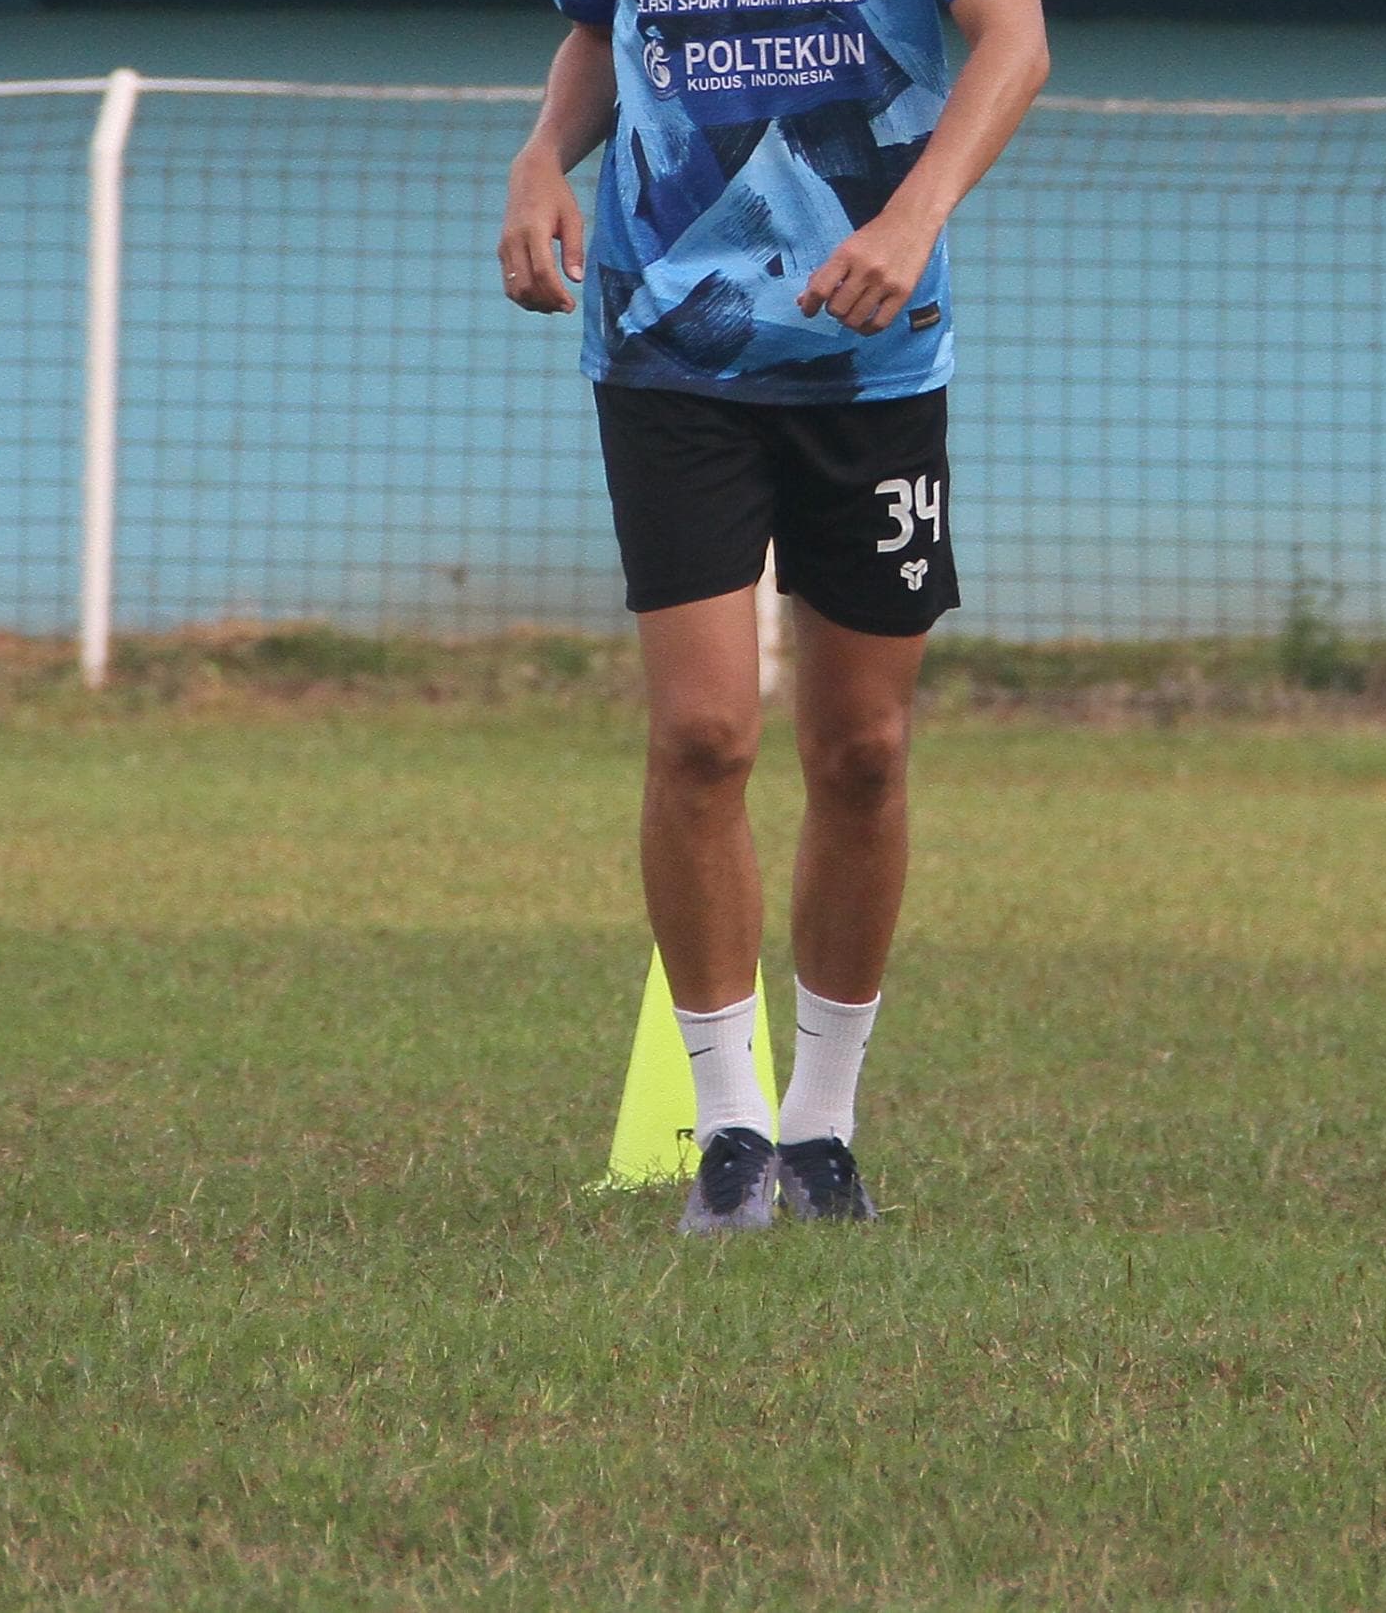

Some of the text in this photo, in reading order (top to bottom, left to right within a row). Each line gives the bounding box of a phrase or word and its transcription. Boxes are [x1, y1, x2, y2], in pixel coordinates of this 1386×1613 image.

[684, 33, 866, 76] POLTEKUN
[687, 69, 834, 92] KUDUS, INDONESIA
[874, 474, 941, 553] 34
